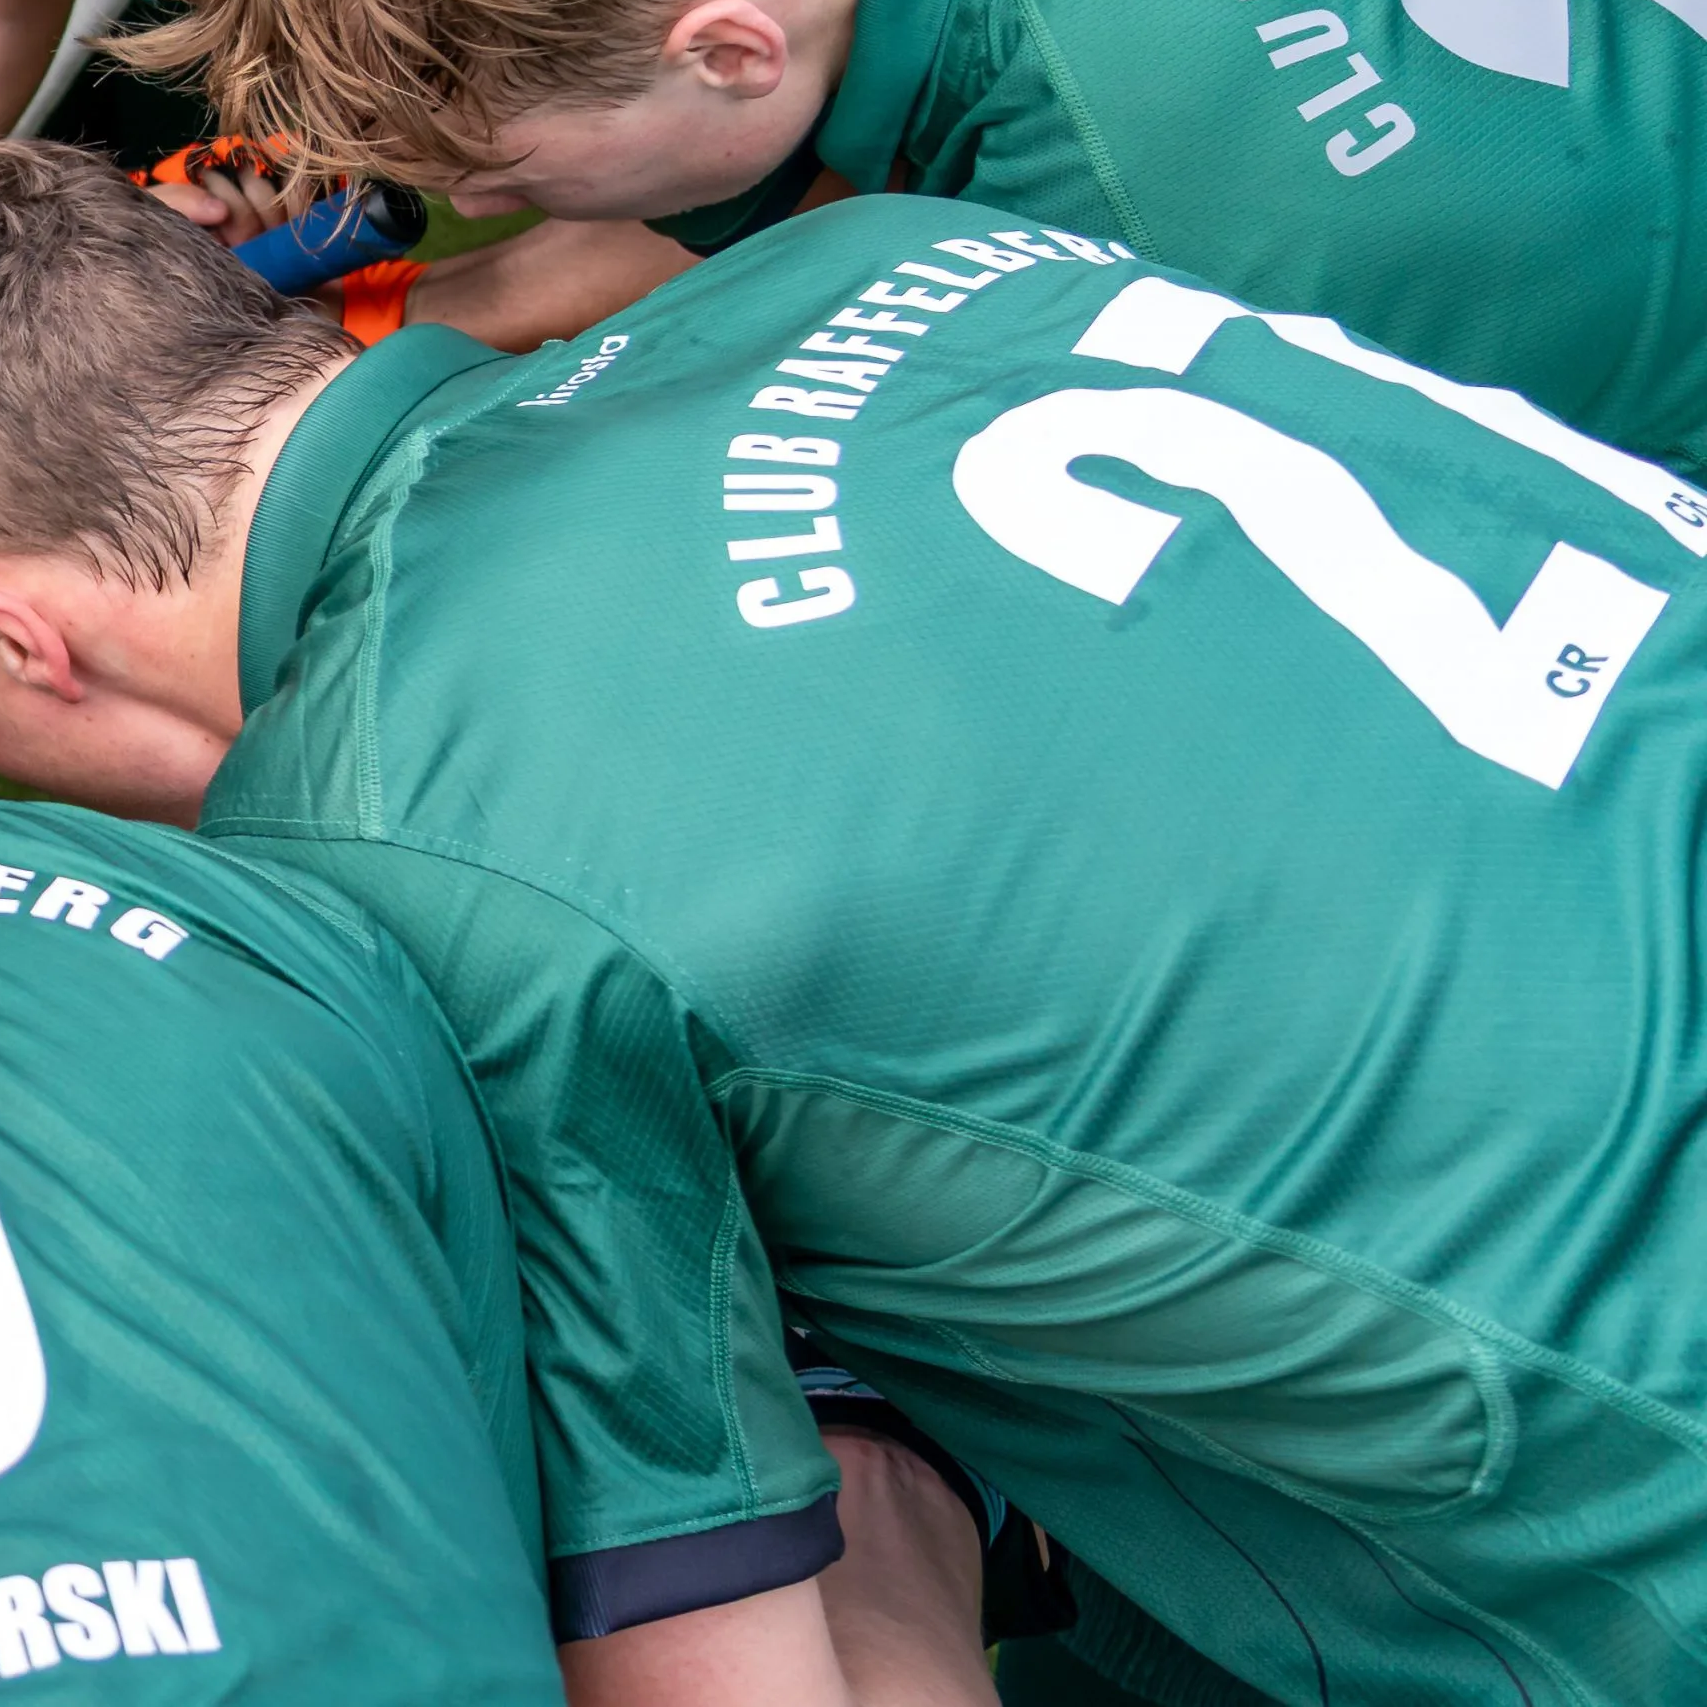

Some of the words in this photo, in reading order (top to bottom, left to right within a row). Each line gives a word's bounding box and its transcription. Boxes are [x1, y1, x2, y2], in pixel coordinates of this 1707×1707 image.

[722, 431, 857, 630] CLUB
[952, 275, 1707, 791] 27
[1545, 643, 1610, 699] CR
